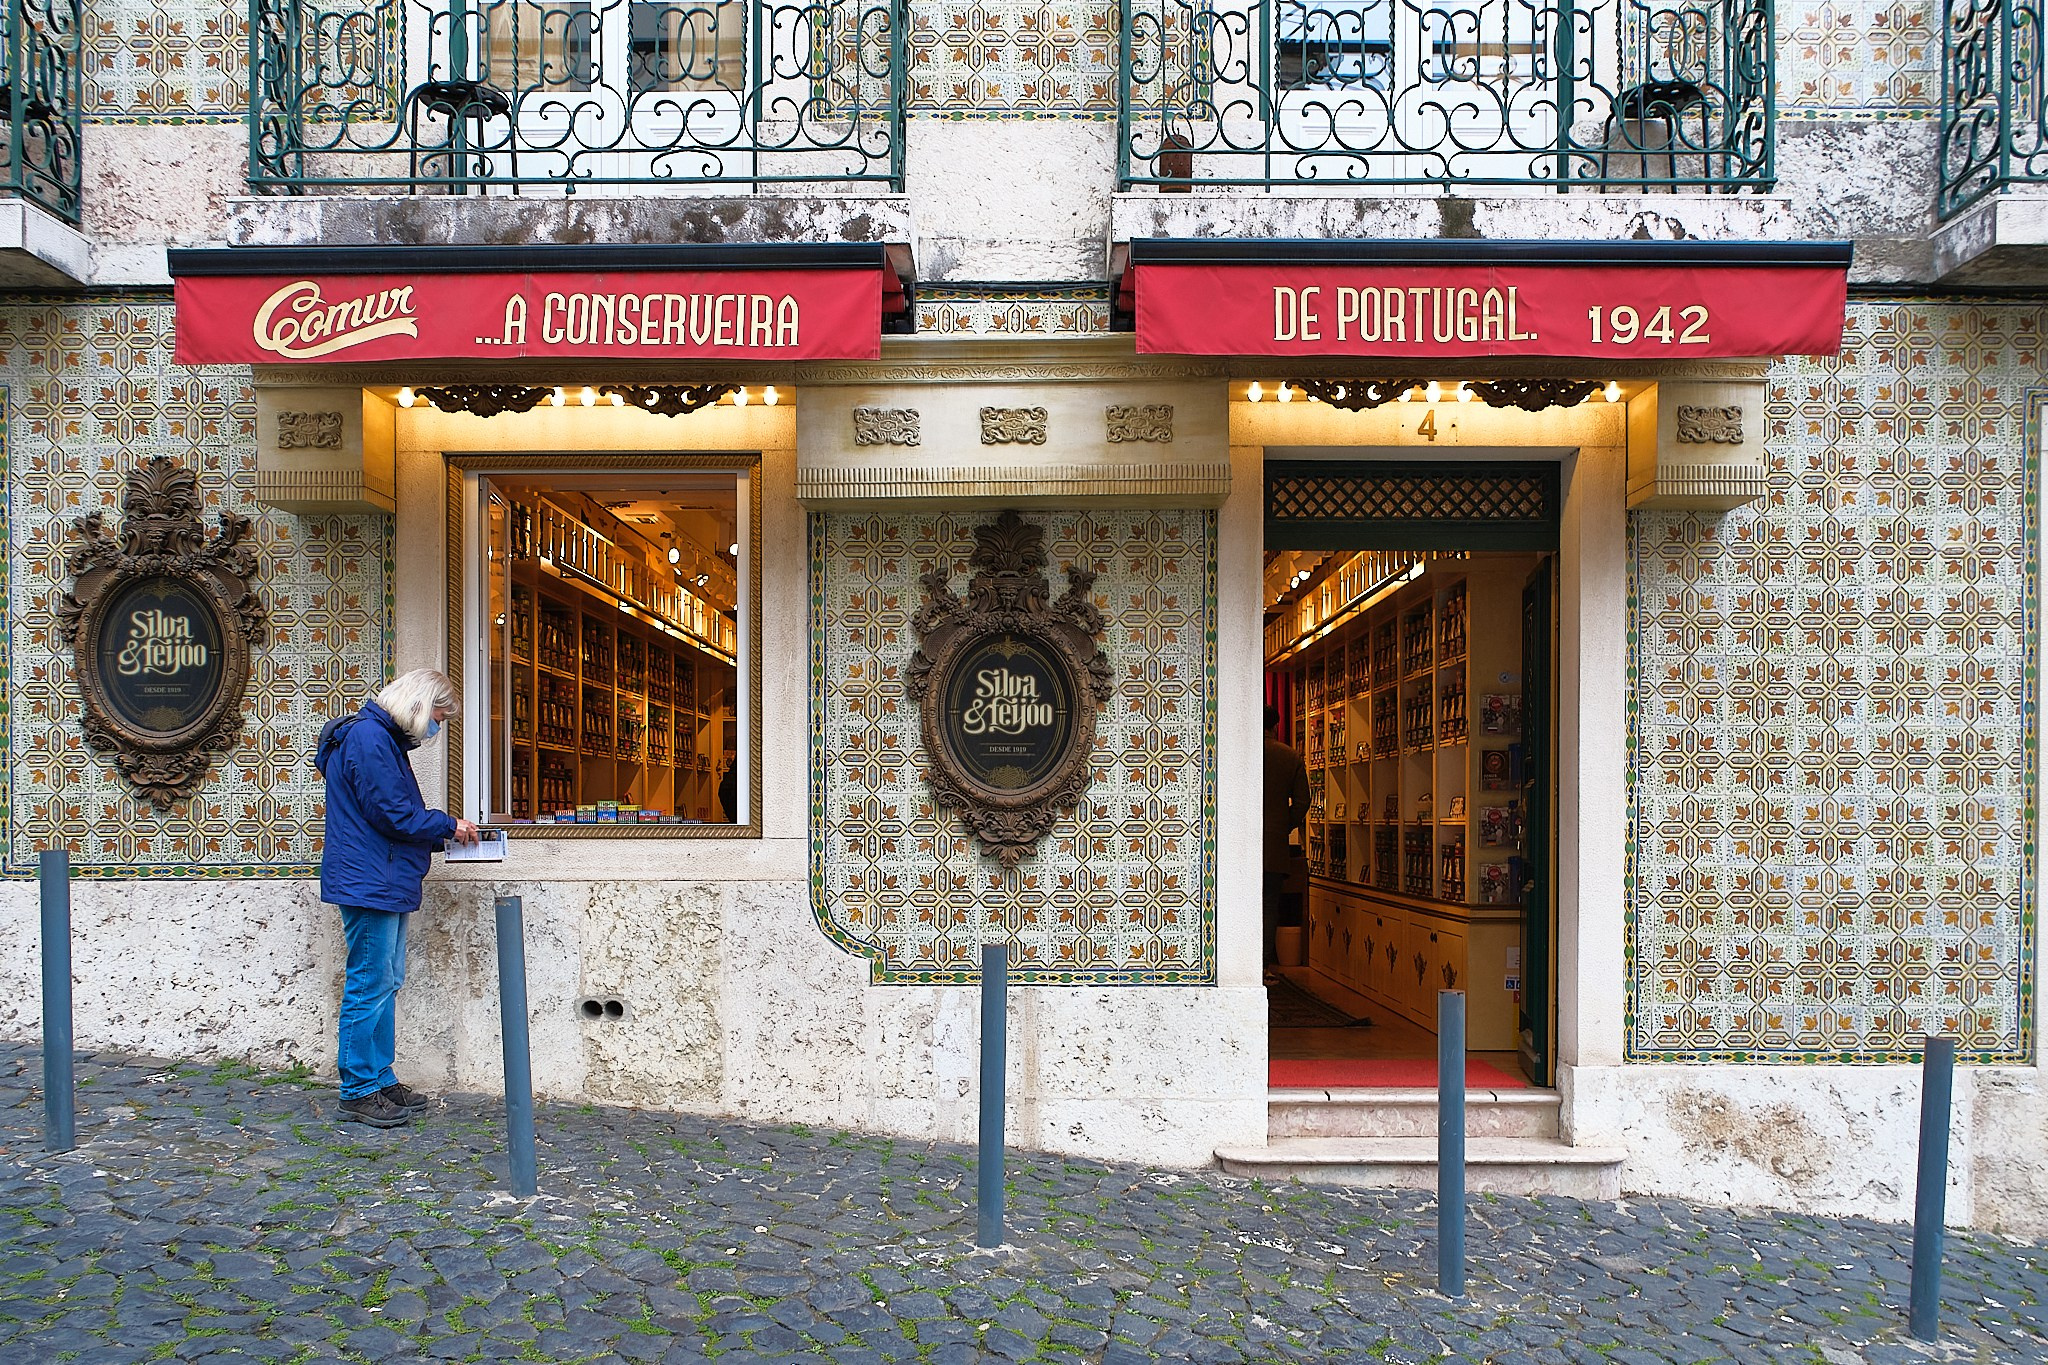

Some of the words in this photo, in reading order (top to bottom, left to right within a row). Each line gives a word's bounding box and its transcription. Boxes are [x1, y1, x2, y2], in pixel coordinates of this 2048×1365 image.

[253, 280, 419, 359] Comur
[542, 292, 800, 347] CONSERVEIRA
[1273, 286, 1321, 341] DE
[1336, 286, 1538, 342] PORTUGAL.
[1588, 304, 1710, 344] 1942
[1417, 409, 1438, 442] 4
[130, 609, 195, 639] Silva
[976, 668, 1040, 698] Silva
